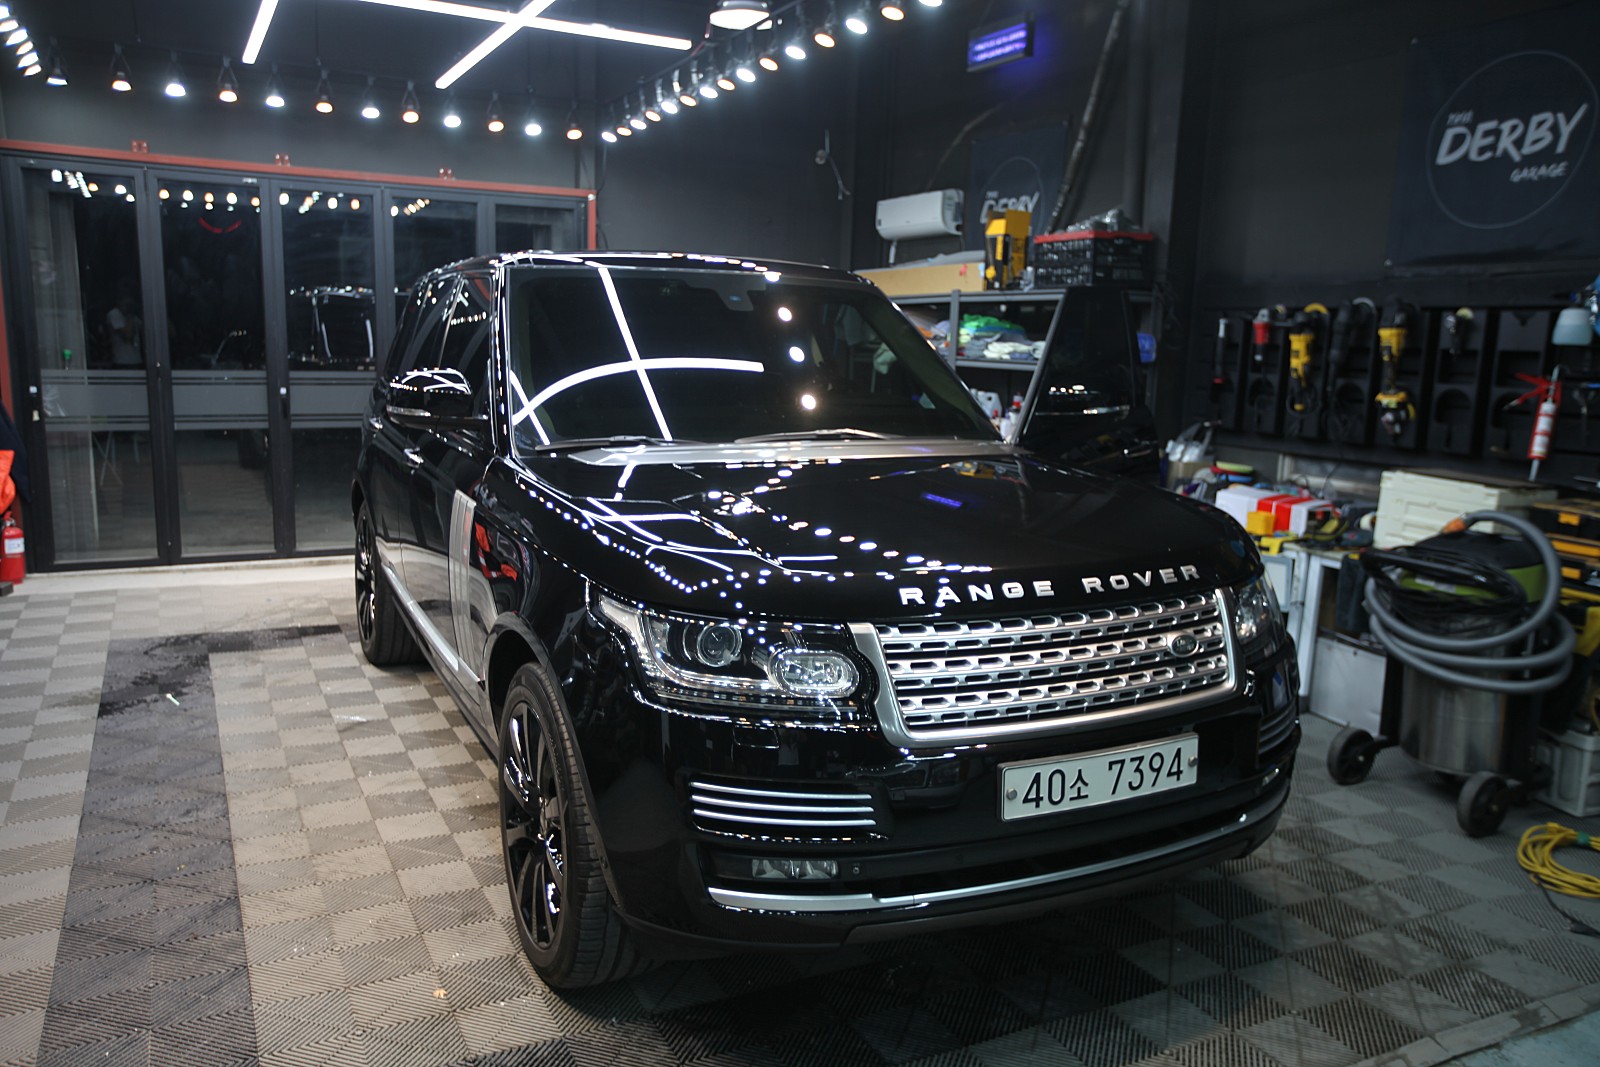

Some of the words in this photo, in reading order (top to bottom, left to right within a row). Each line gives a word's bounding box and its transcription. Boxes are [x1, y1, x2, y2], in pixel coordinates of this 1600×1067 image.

[1435, 103, 1588, 166] DERBY
[1509, 161, 1568, 182] GARAGE
[899, 580, 1055, 605] RANGE
[1081, 564, 1200, 594] ROVER
[1022, 768, 1089, 808] 40소
[1108, 747, 1184, 795] 7394
